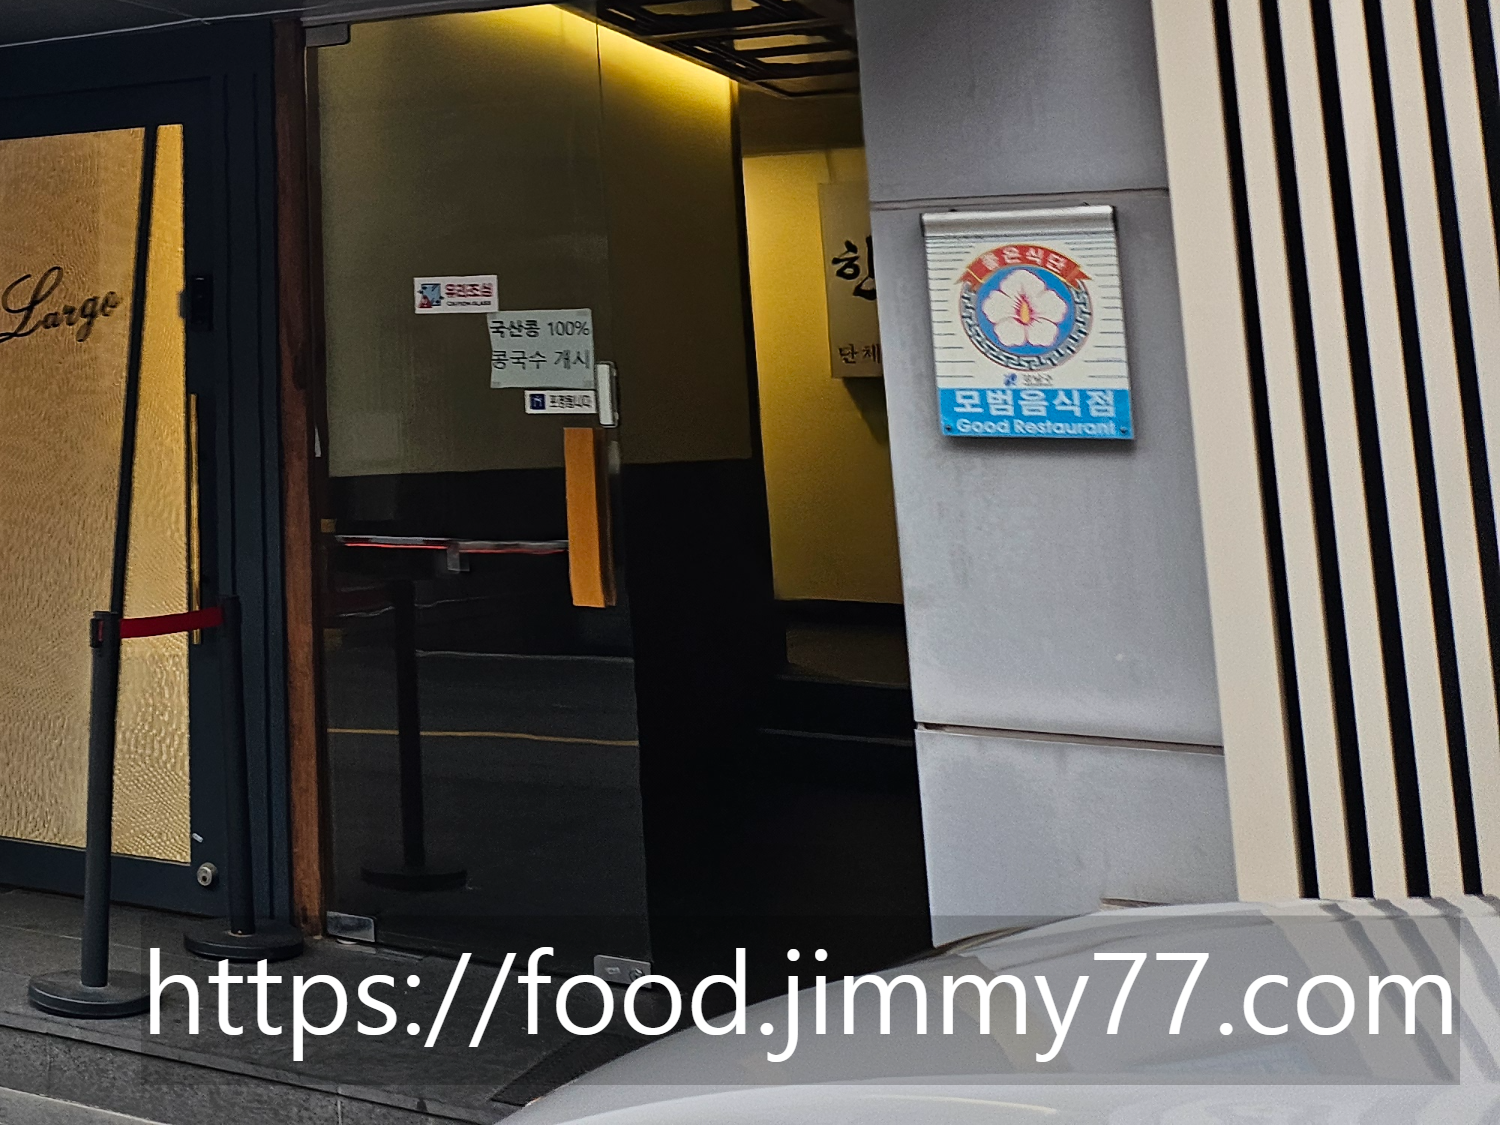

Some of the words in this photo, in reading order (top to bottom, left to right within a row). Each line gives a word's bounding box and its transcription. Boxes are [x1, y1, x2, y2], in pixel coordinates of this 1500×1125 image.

[489, 320, 541, 339] 국산콩
[547, 321, 591, 336] 100%
[491, 350, 548, 370] 콩국수
[553, 350, 591, 370] 개시
[953, 388, 1117, 418] 모범음식점
[956, 418, 1010, 435] Good
[1013, 418, 1117, 436] Restaurant
